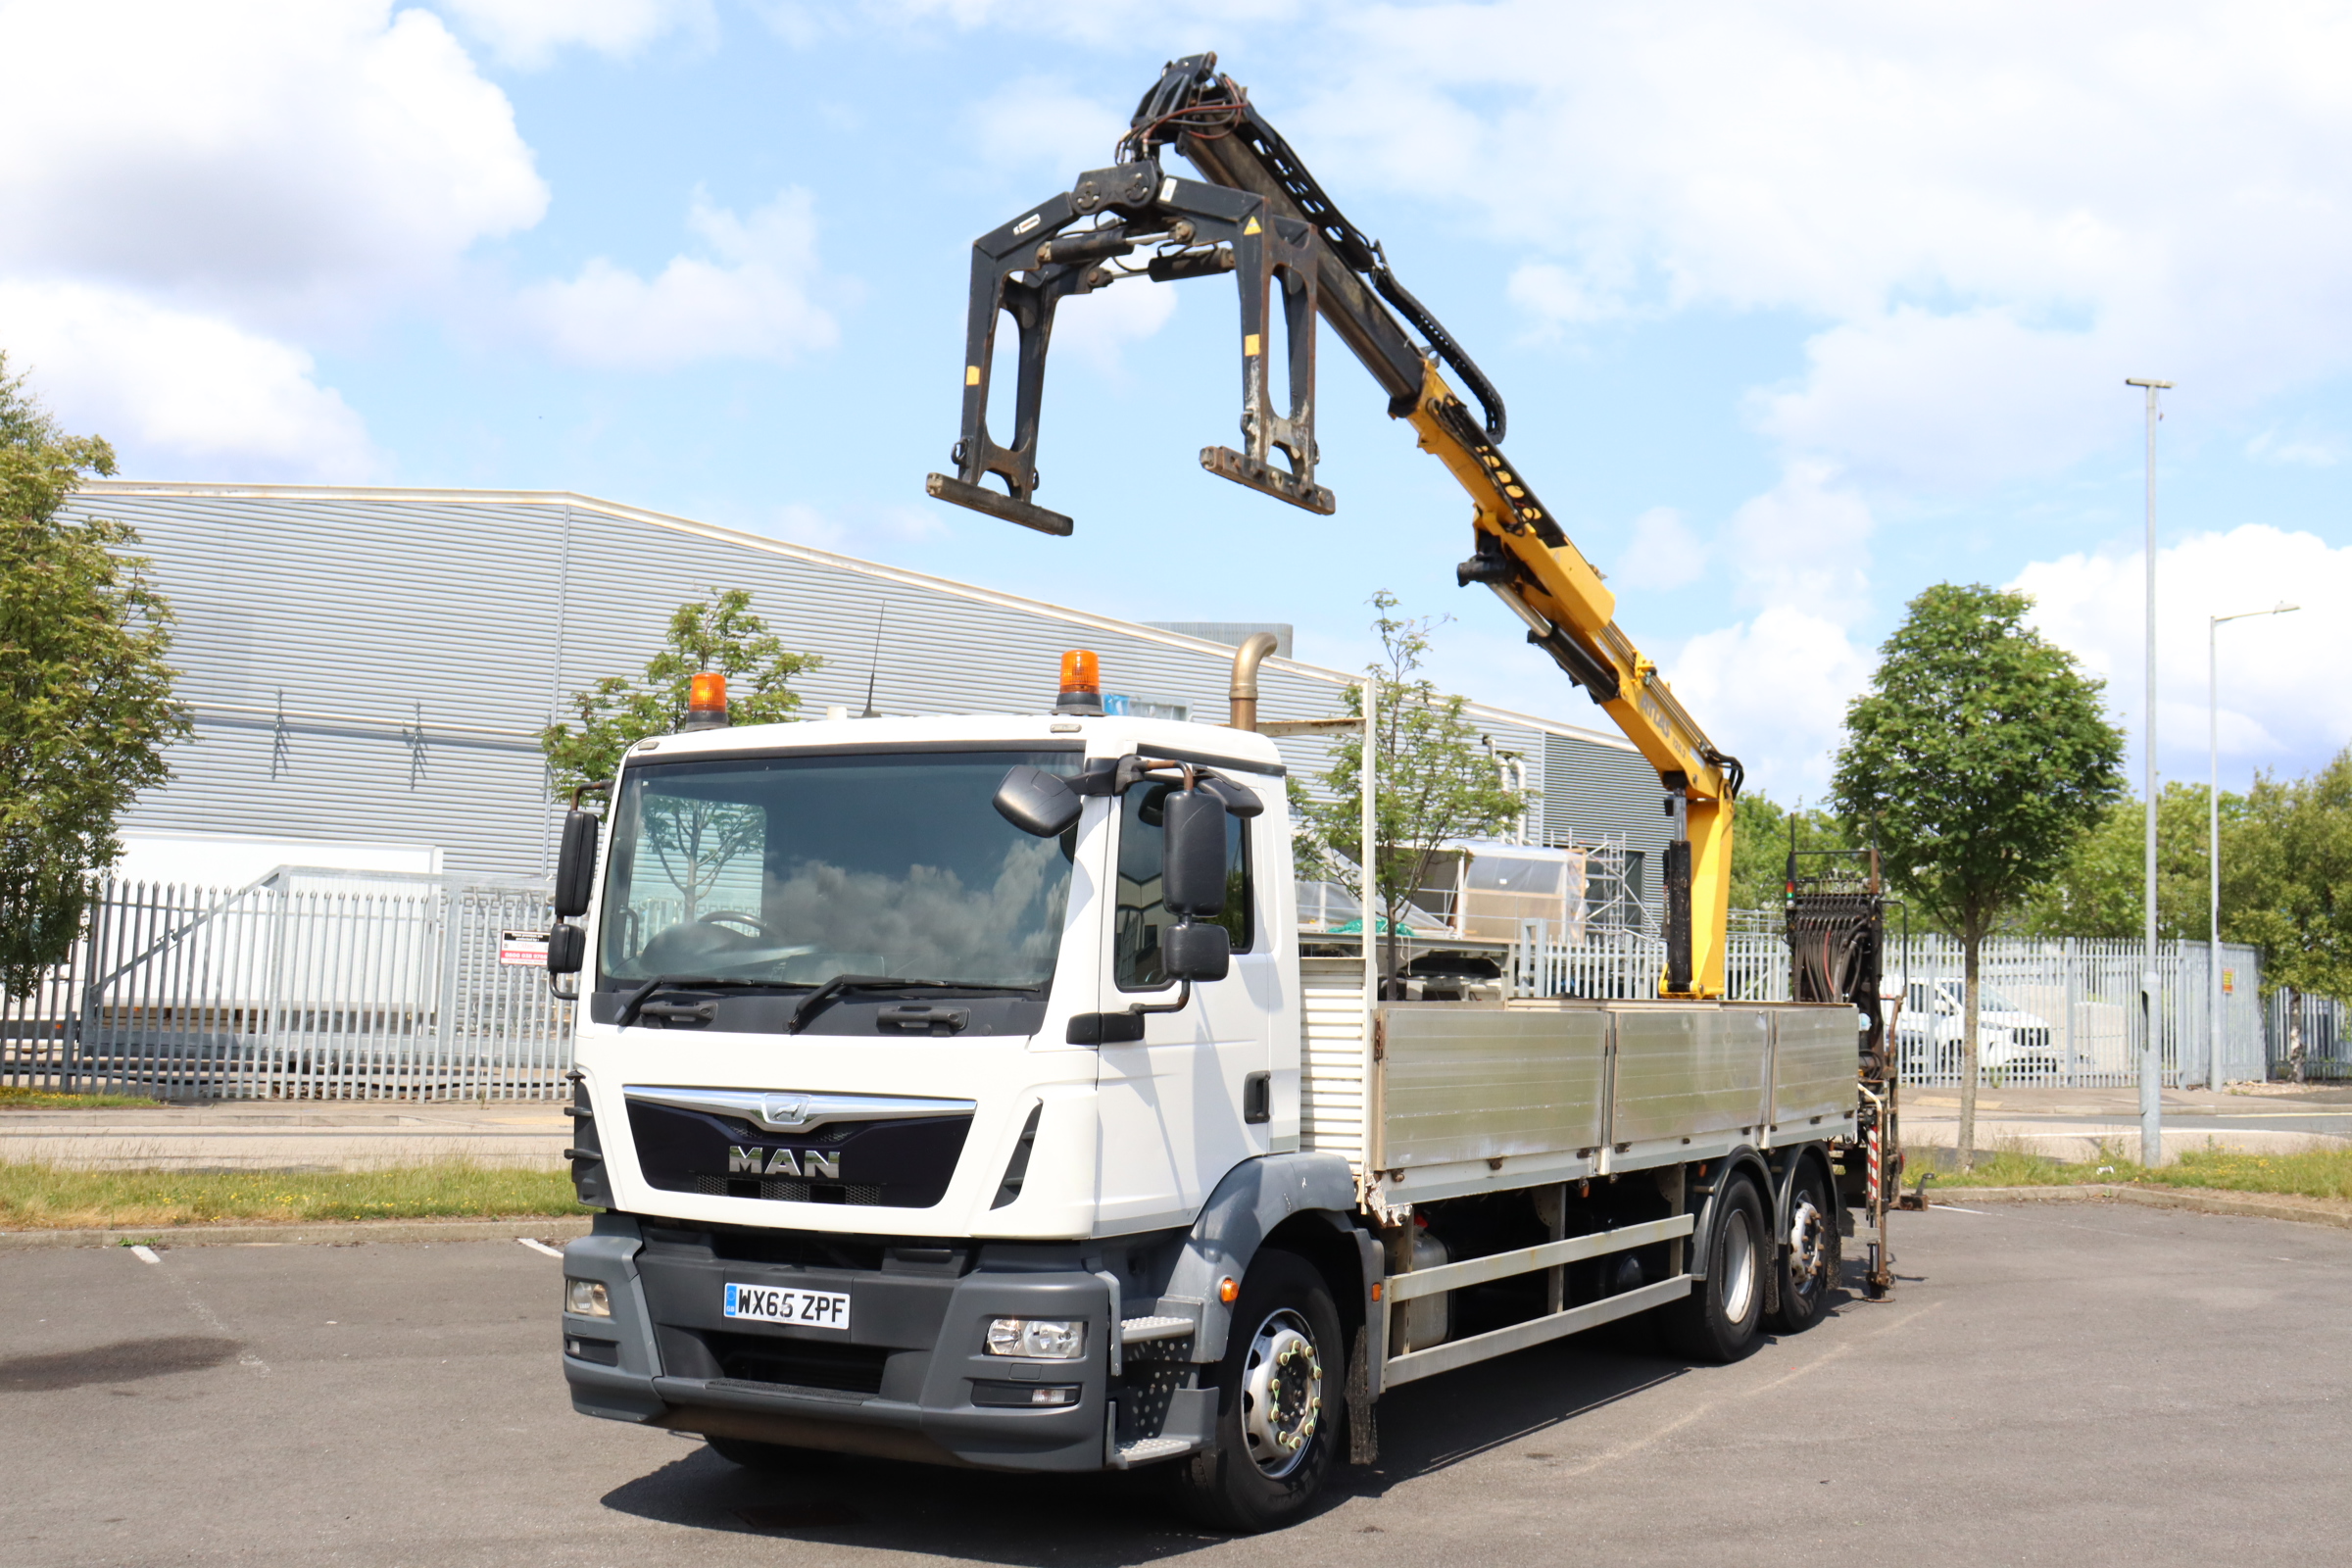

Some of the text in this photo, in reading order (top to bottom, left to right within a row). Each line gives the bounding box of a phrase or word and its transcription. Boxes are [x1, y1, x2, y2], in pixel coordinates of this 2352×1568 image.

[1640, 692, 1671, 738] ATLAS
[729, 1146, 840, 1178] MAN
[738, 1289, 846, 1322] WX65 ZPF
